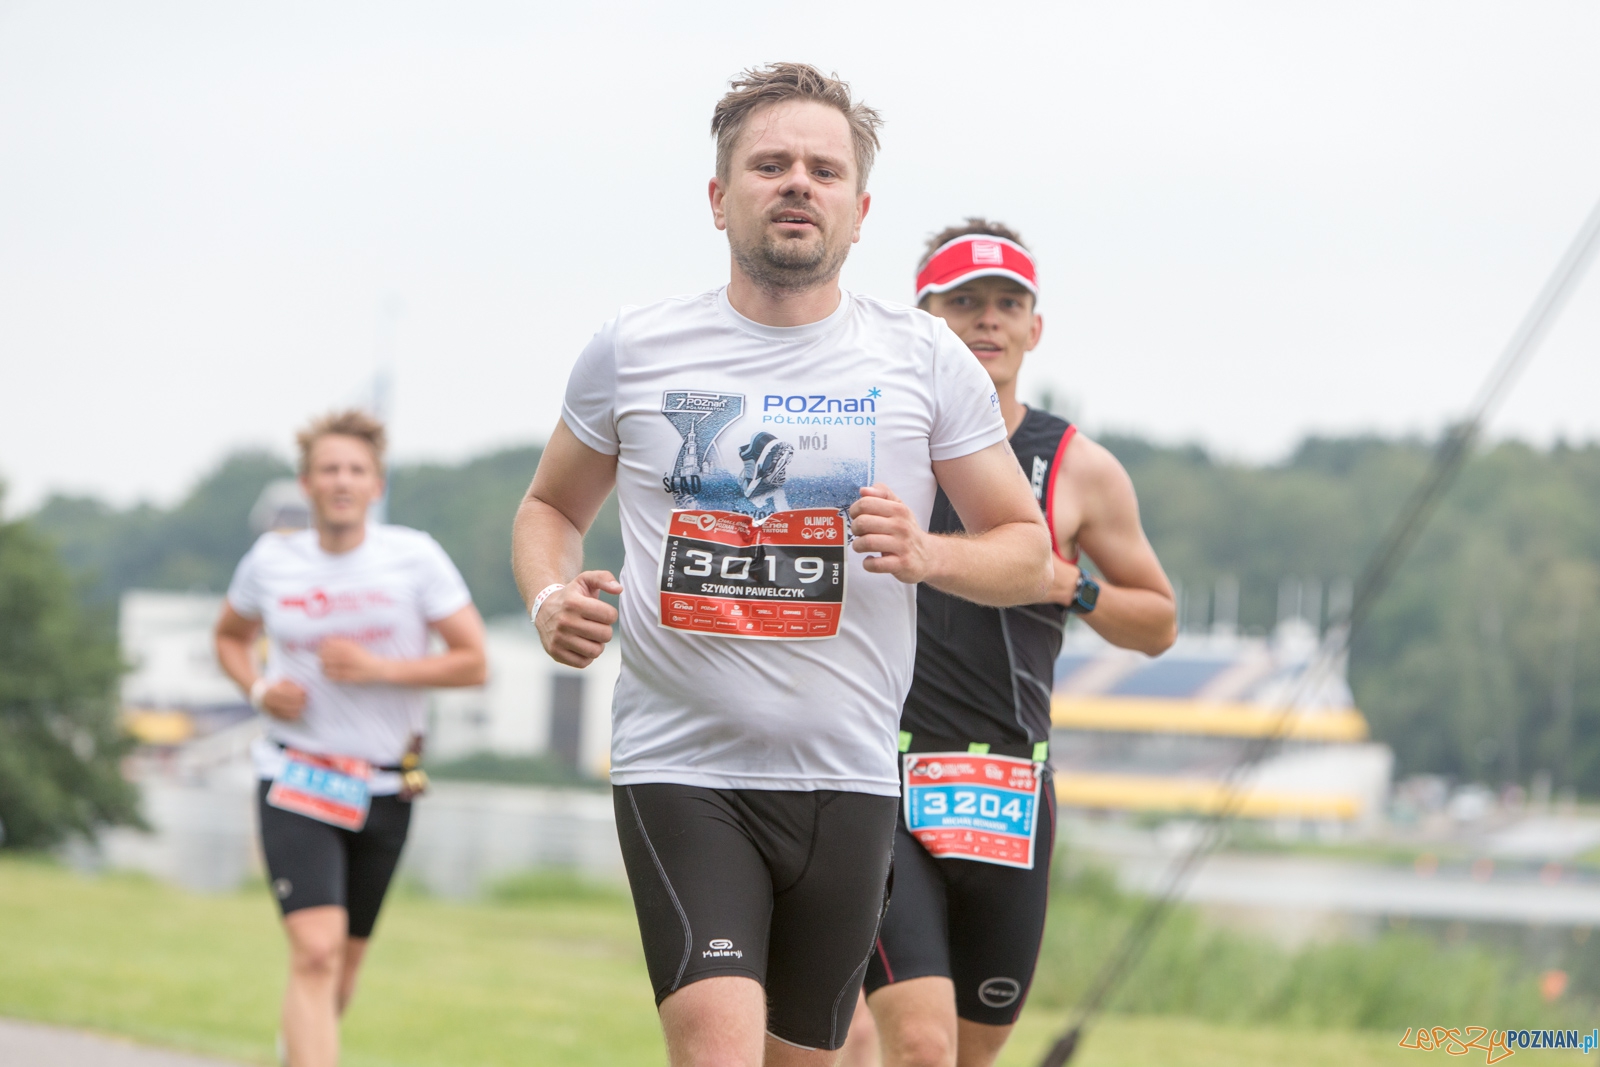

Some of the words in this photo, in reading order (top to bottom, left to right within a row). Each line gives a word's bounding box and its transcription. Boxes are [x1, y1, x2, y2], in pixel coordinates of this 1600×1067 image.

[762, 414, 876, 426] PÓŁMARATON
[799, 432, 828, 451] MÓJ
[662, 472, 702, 494] ŚLAD
[804, 516, 835, 526] OLIMPIC
[667, 540, 679, 588] 23.07.2016
[683, 549, 825, 584] 3019
[701, 583, 745, 596] SZYMON
[745, 586, 805, 598] PAWELCZYK
[923, 791, 1023, 822] 3204
